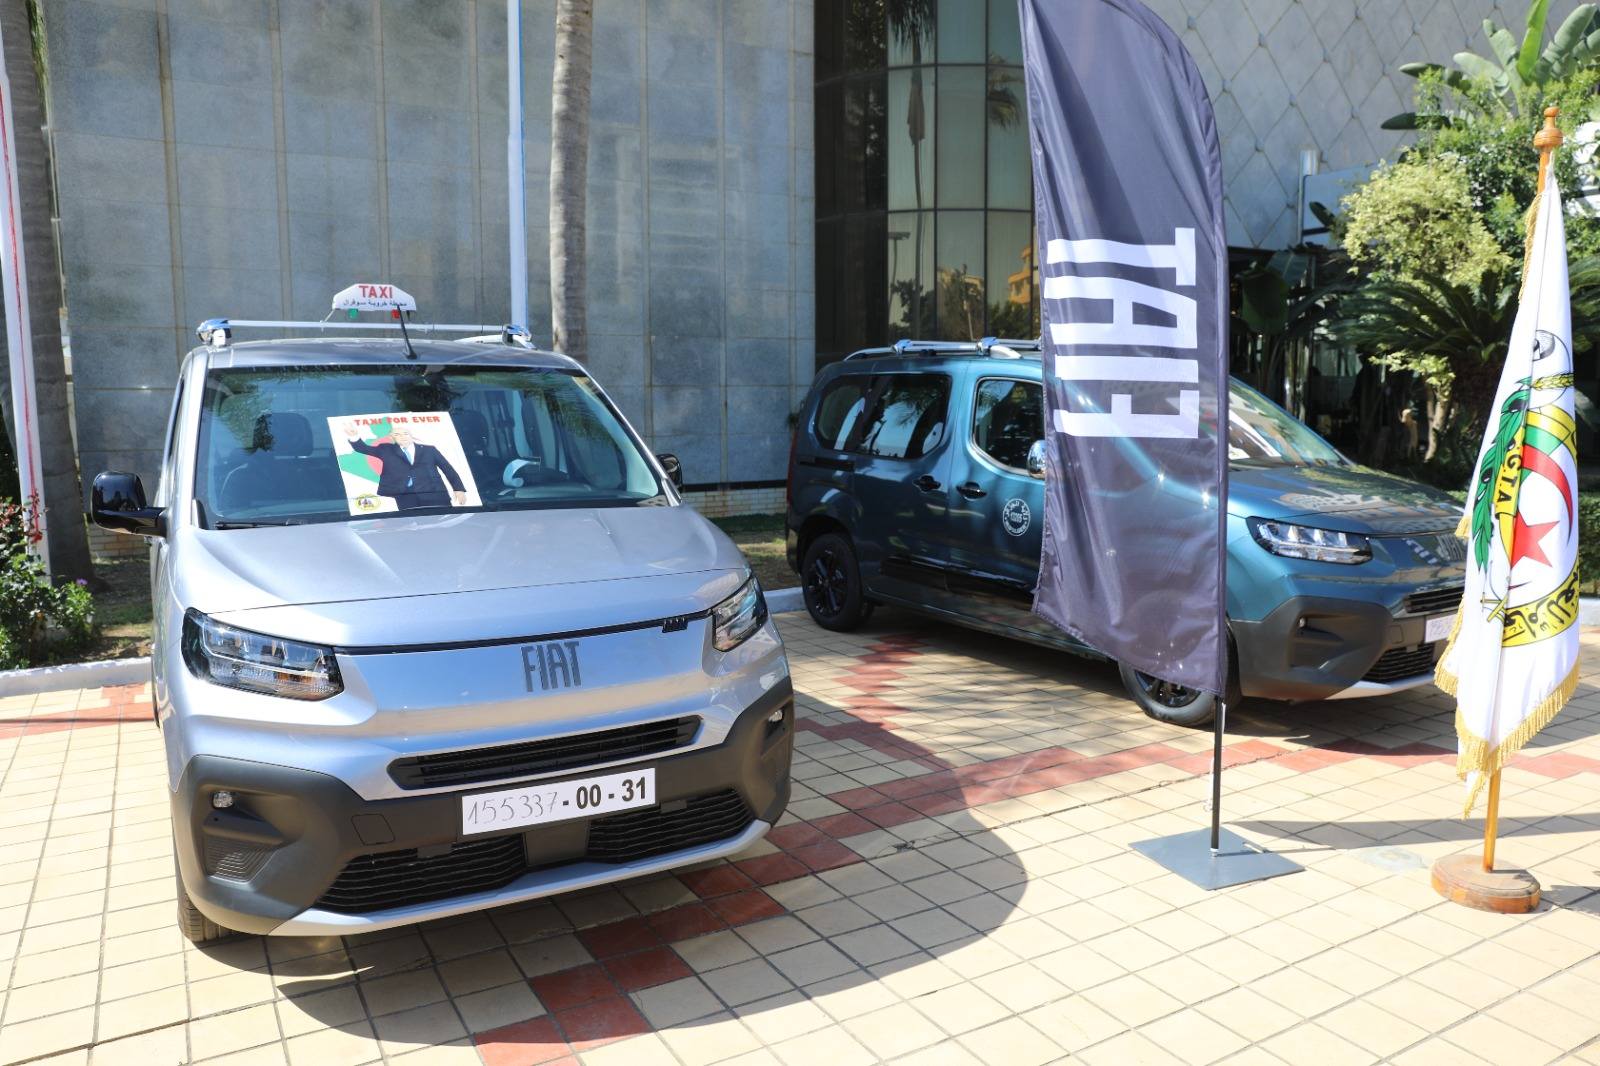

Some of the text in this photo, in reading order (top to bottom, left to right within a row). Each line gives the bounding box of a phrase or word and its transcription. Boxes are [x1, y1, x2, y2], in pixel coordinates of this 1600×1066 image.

[358, 285, 393, 299] TAXI
[354, 415, 441, 427] TAXI FOR EVER
[520, 641, 582, 692] FIAT
